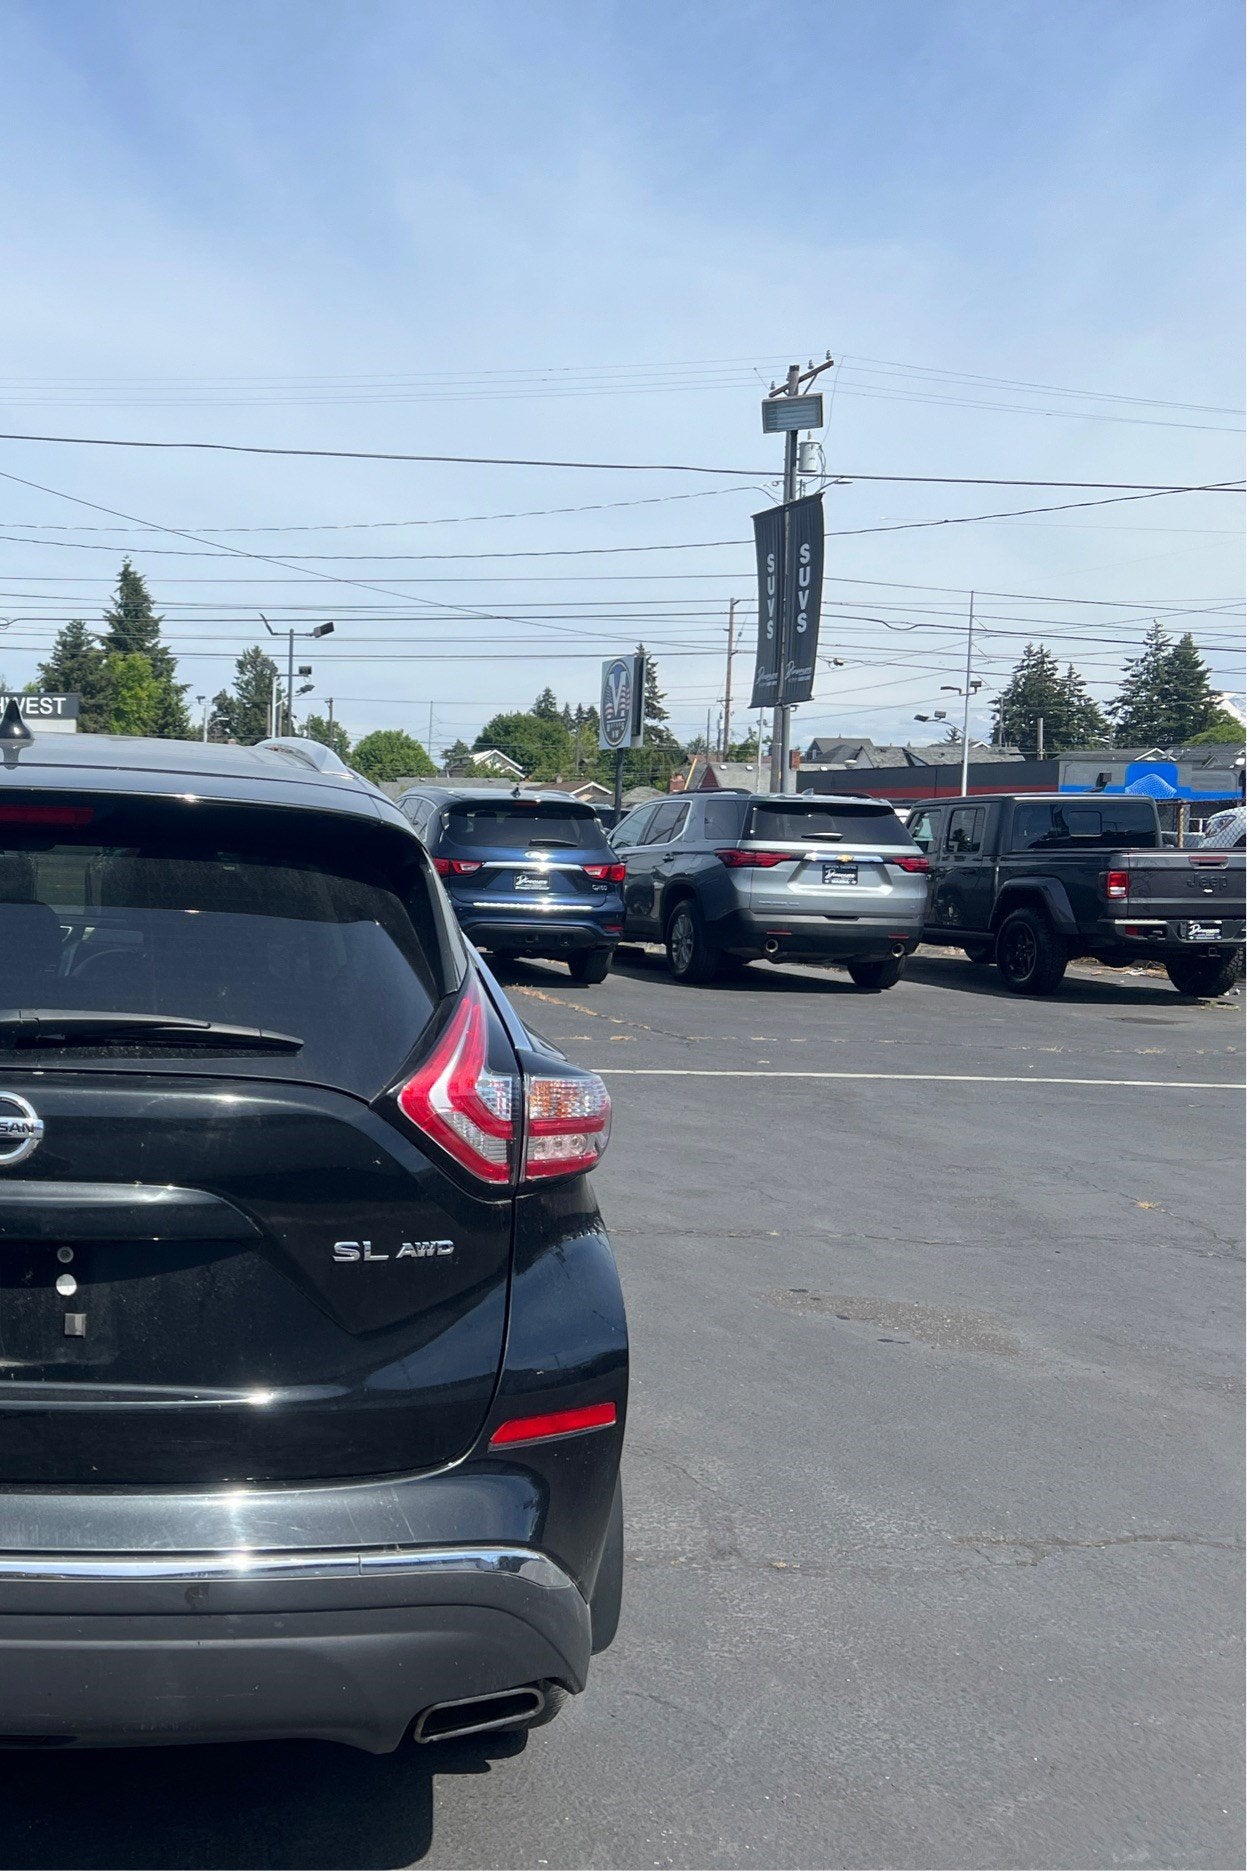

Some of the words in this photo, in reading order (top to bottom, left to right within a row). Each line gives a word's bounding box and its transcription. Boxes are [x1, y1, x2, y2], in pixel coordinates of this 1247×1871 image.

[766, 553, 775, 640] SUVS
[797, 543, 811, 633] SUVS
[333, 1240, 389, 1261] SL
[395, 1240, 454, 1258] AWD
